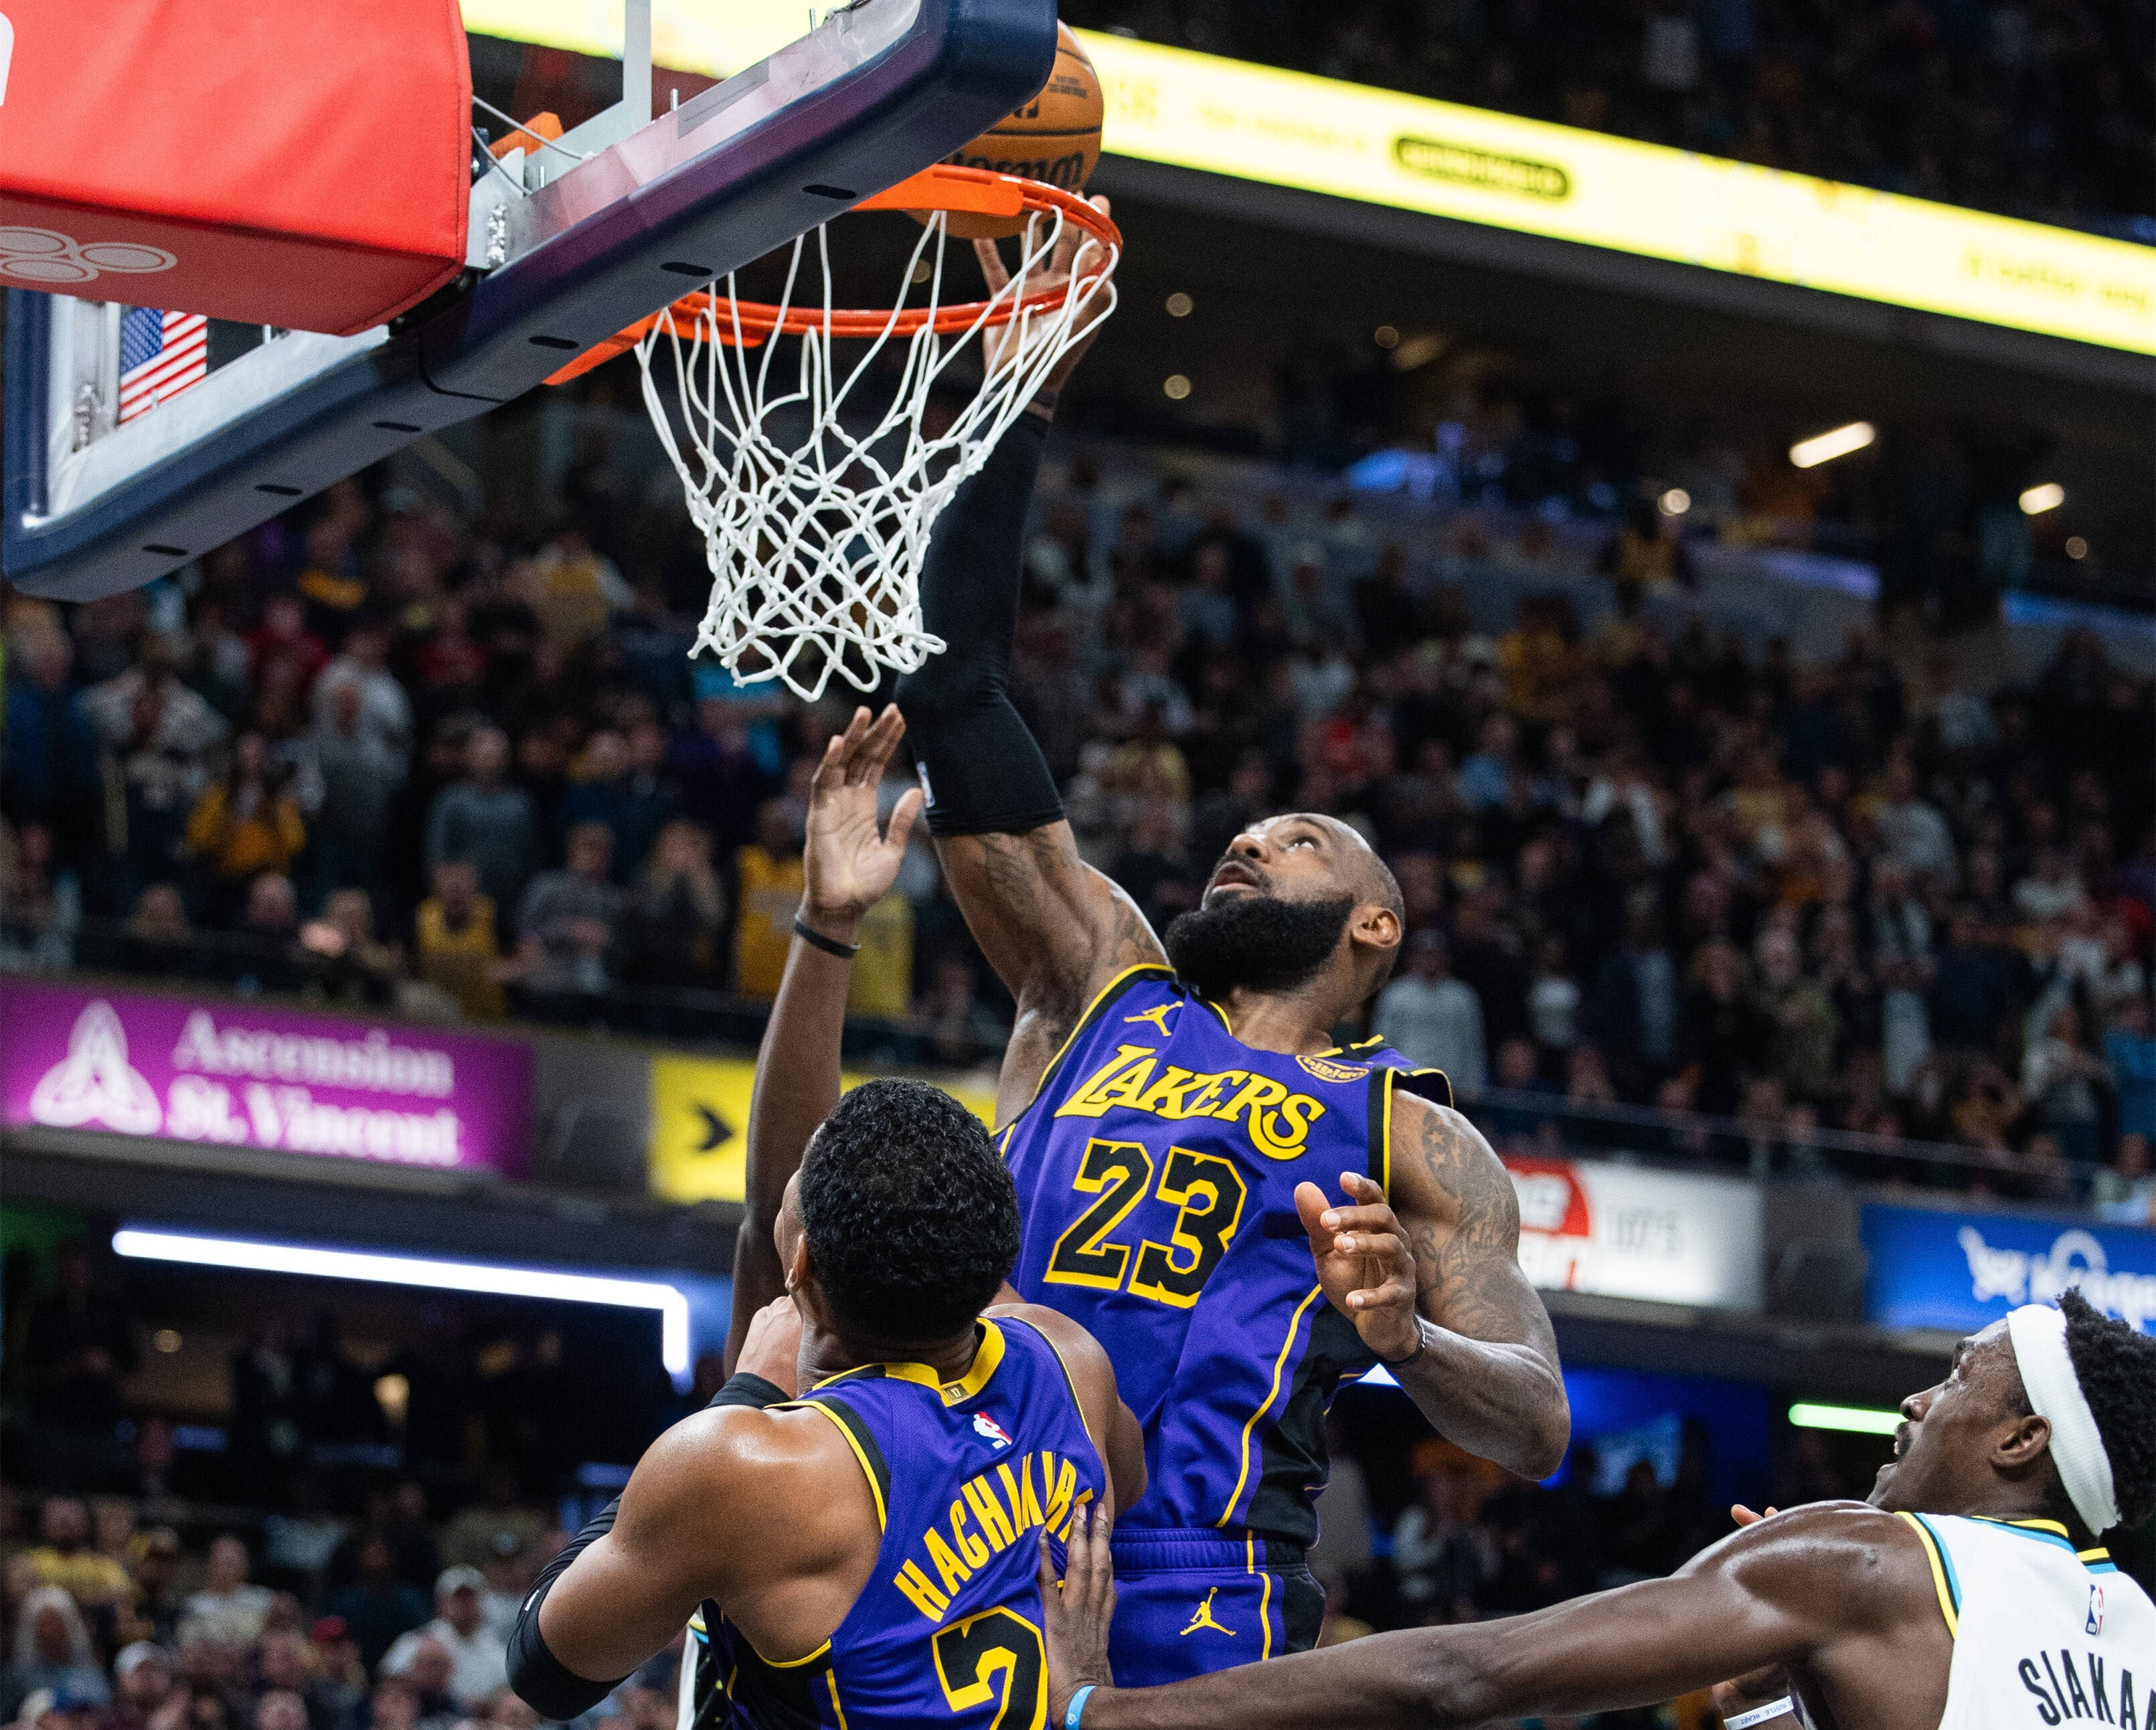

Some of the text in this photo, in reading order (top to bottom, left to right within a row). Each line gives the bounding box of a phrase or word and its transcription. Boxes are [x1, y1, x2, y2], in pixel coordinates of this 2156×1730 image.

[1054, 1044, 1326, 1161] LAKERS
[1042, 1137, 1247, 1309] 23
[893, 1450, 1094, 1623] HACHIMR
